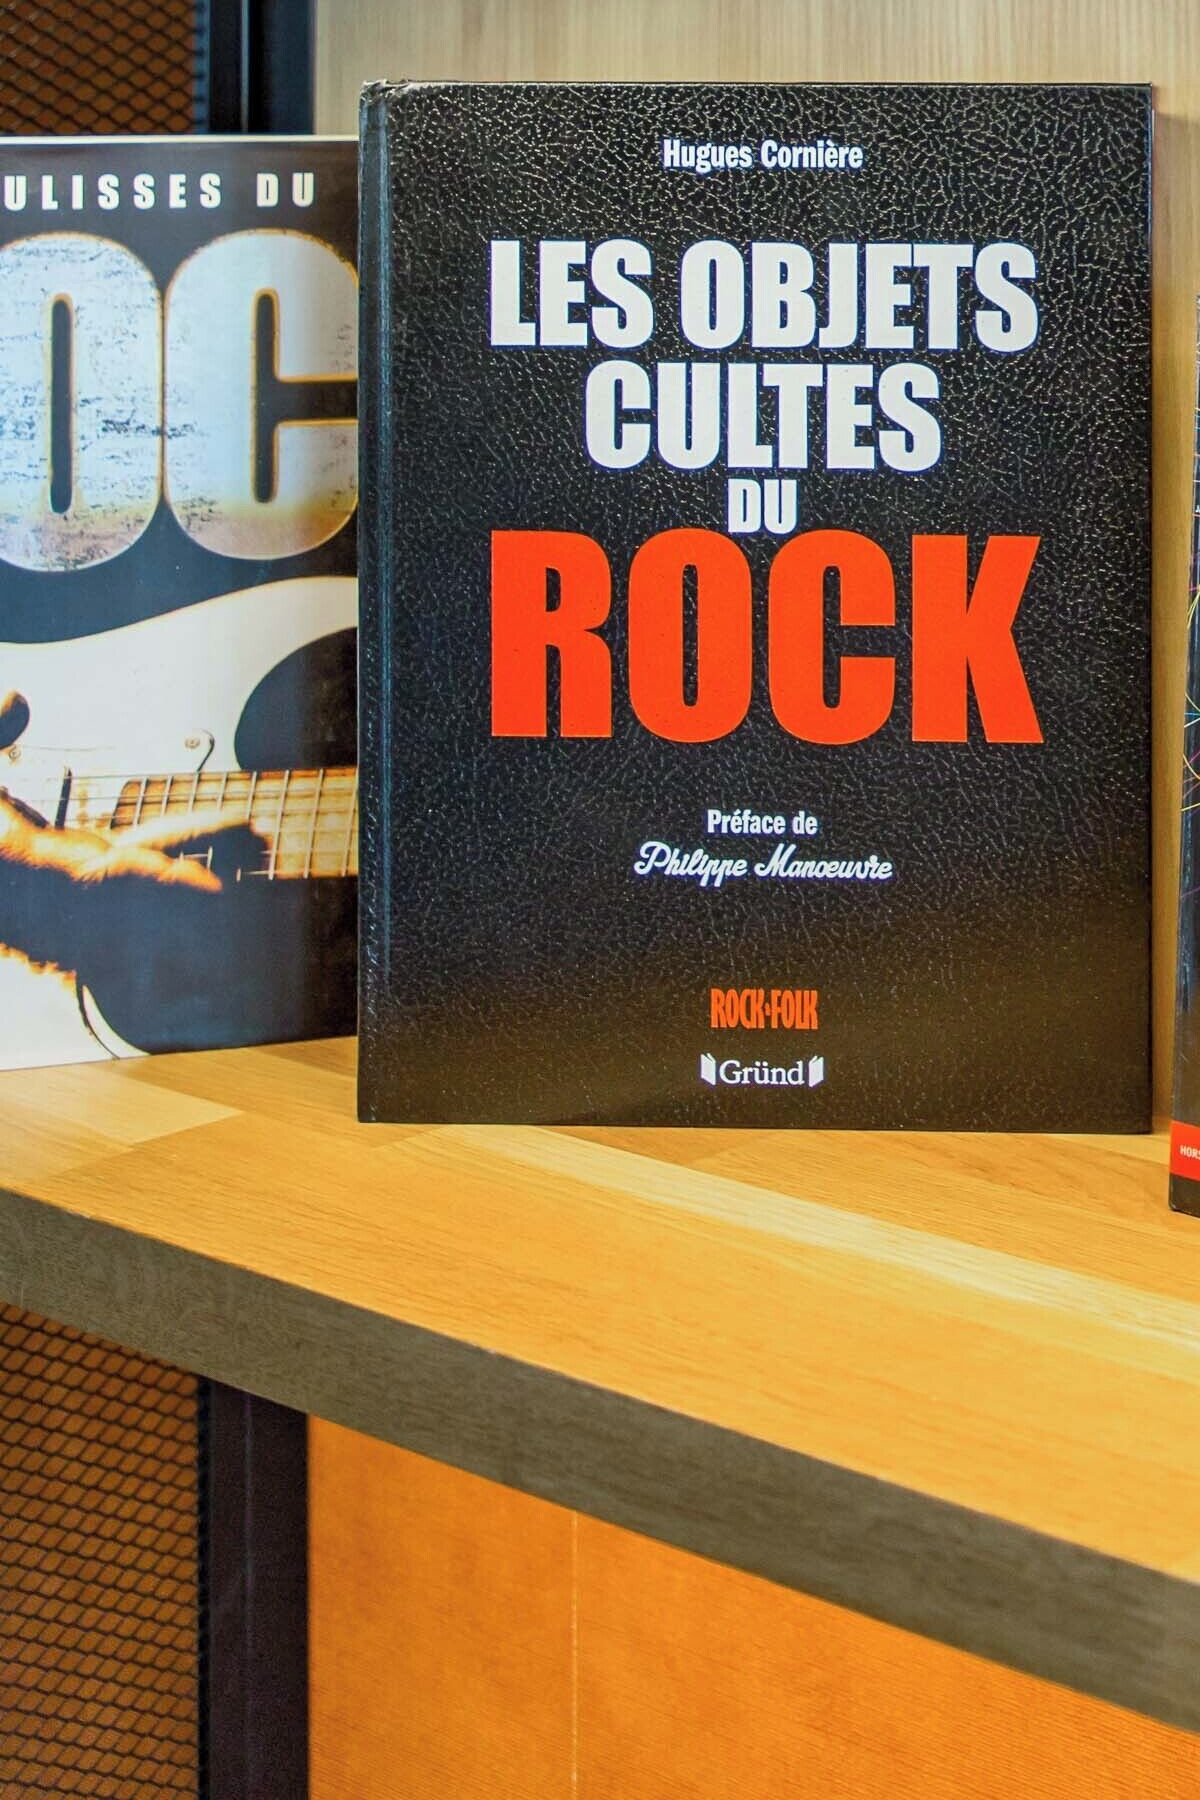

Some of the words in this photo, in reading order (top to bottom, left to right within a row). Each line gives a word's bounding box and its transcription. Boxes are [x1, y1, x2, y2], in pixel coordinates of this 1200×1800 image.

[663, 138, 753, 174] Hugues
[760, 138, 864, 170] Cornière
[256, 172, 315, 208] DU
[490, 239, 654, 349] LES
[680, 240, 1039, 353] OBJETS
[585, 360, 942, 472] CULTES
[727, 478, 798, 535] DU
[490, 527, 1042, 743] ROCK
[706, 808, 786, 834] Préface
[792, 810, 819, 836] de
[633, 840, 748, 888] Philippe
[718, 1058, 806, 1086] Gründ
